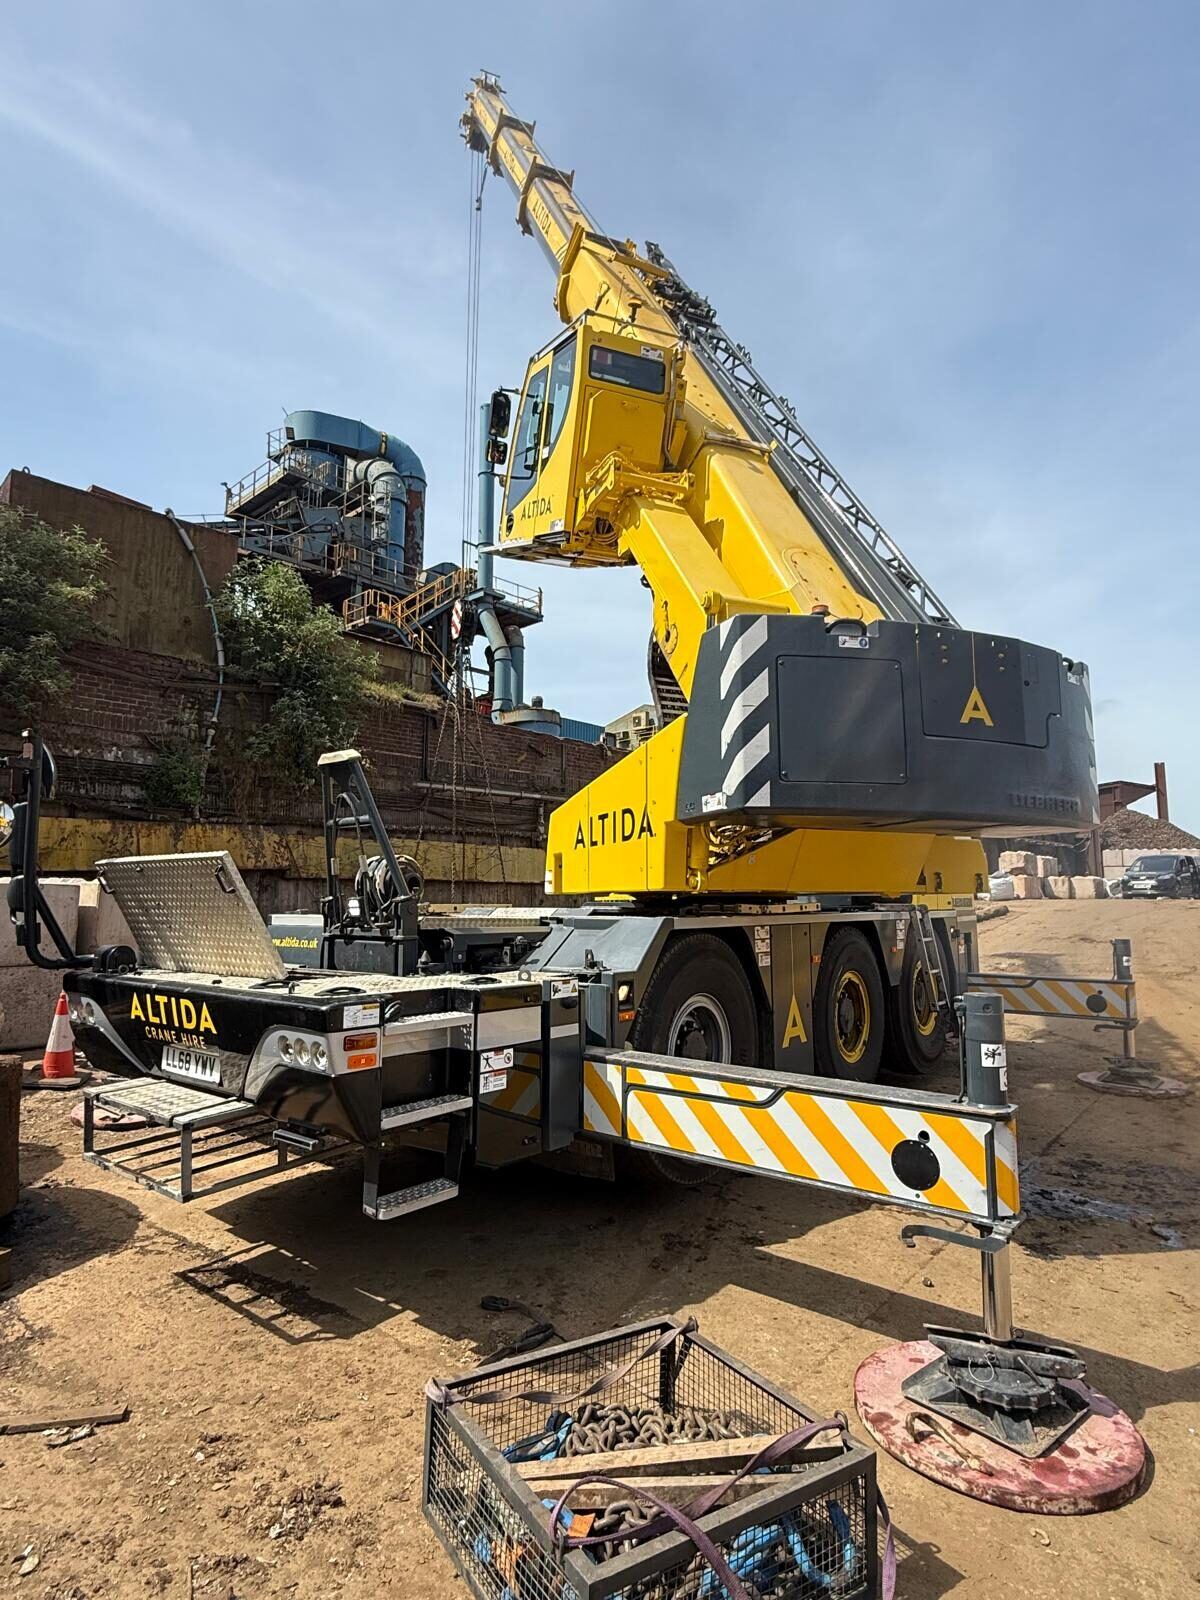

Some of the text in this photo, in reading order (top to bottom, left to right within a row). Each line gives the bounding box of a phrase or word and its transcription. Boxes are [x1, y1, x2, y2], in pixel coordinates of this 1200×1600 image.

[532, 199, 552, 236] ALTIDA
[520, 496, 552, 521] ALTIDA
[960, 686, 994, 726] A
[574, 802, 655, 850] ALTIDA
[130, 991, 218, 1035] ALTIDA
[781, 993, 808, 1049] A
[145, 1025, 207, 1050] CRANE HIRE
[166, 1047, 216, 1077] LL68 YWV
